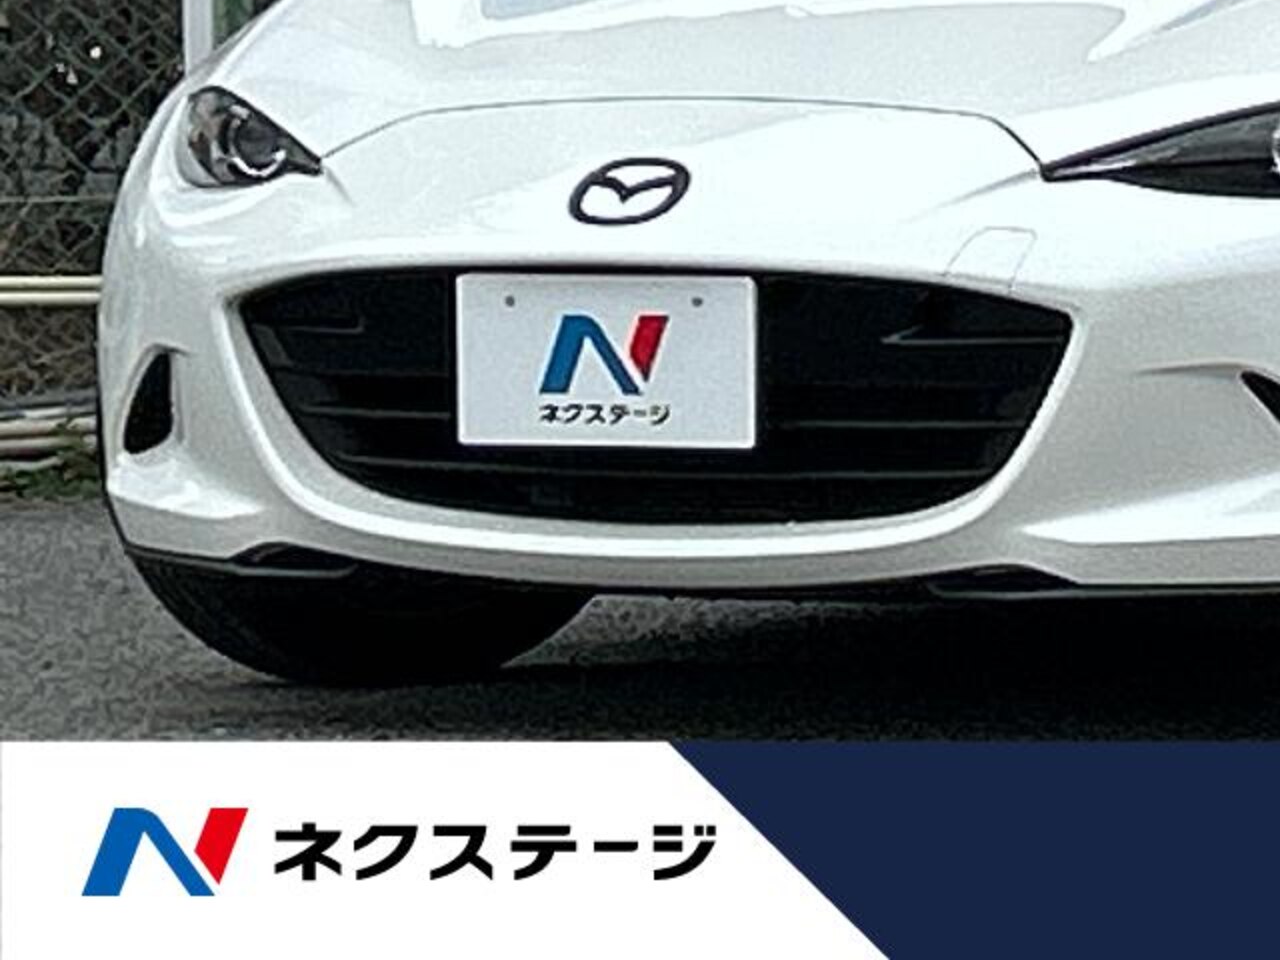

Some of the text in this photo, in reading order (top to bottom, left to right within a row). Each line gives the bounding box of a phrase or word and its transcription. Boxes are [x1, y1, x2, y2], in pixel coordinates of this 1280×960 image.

[539, 404, 671, 425] ネクステージ
